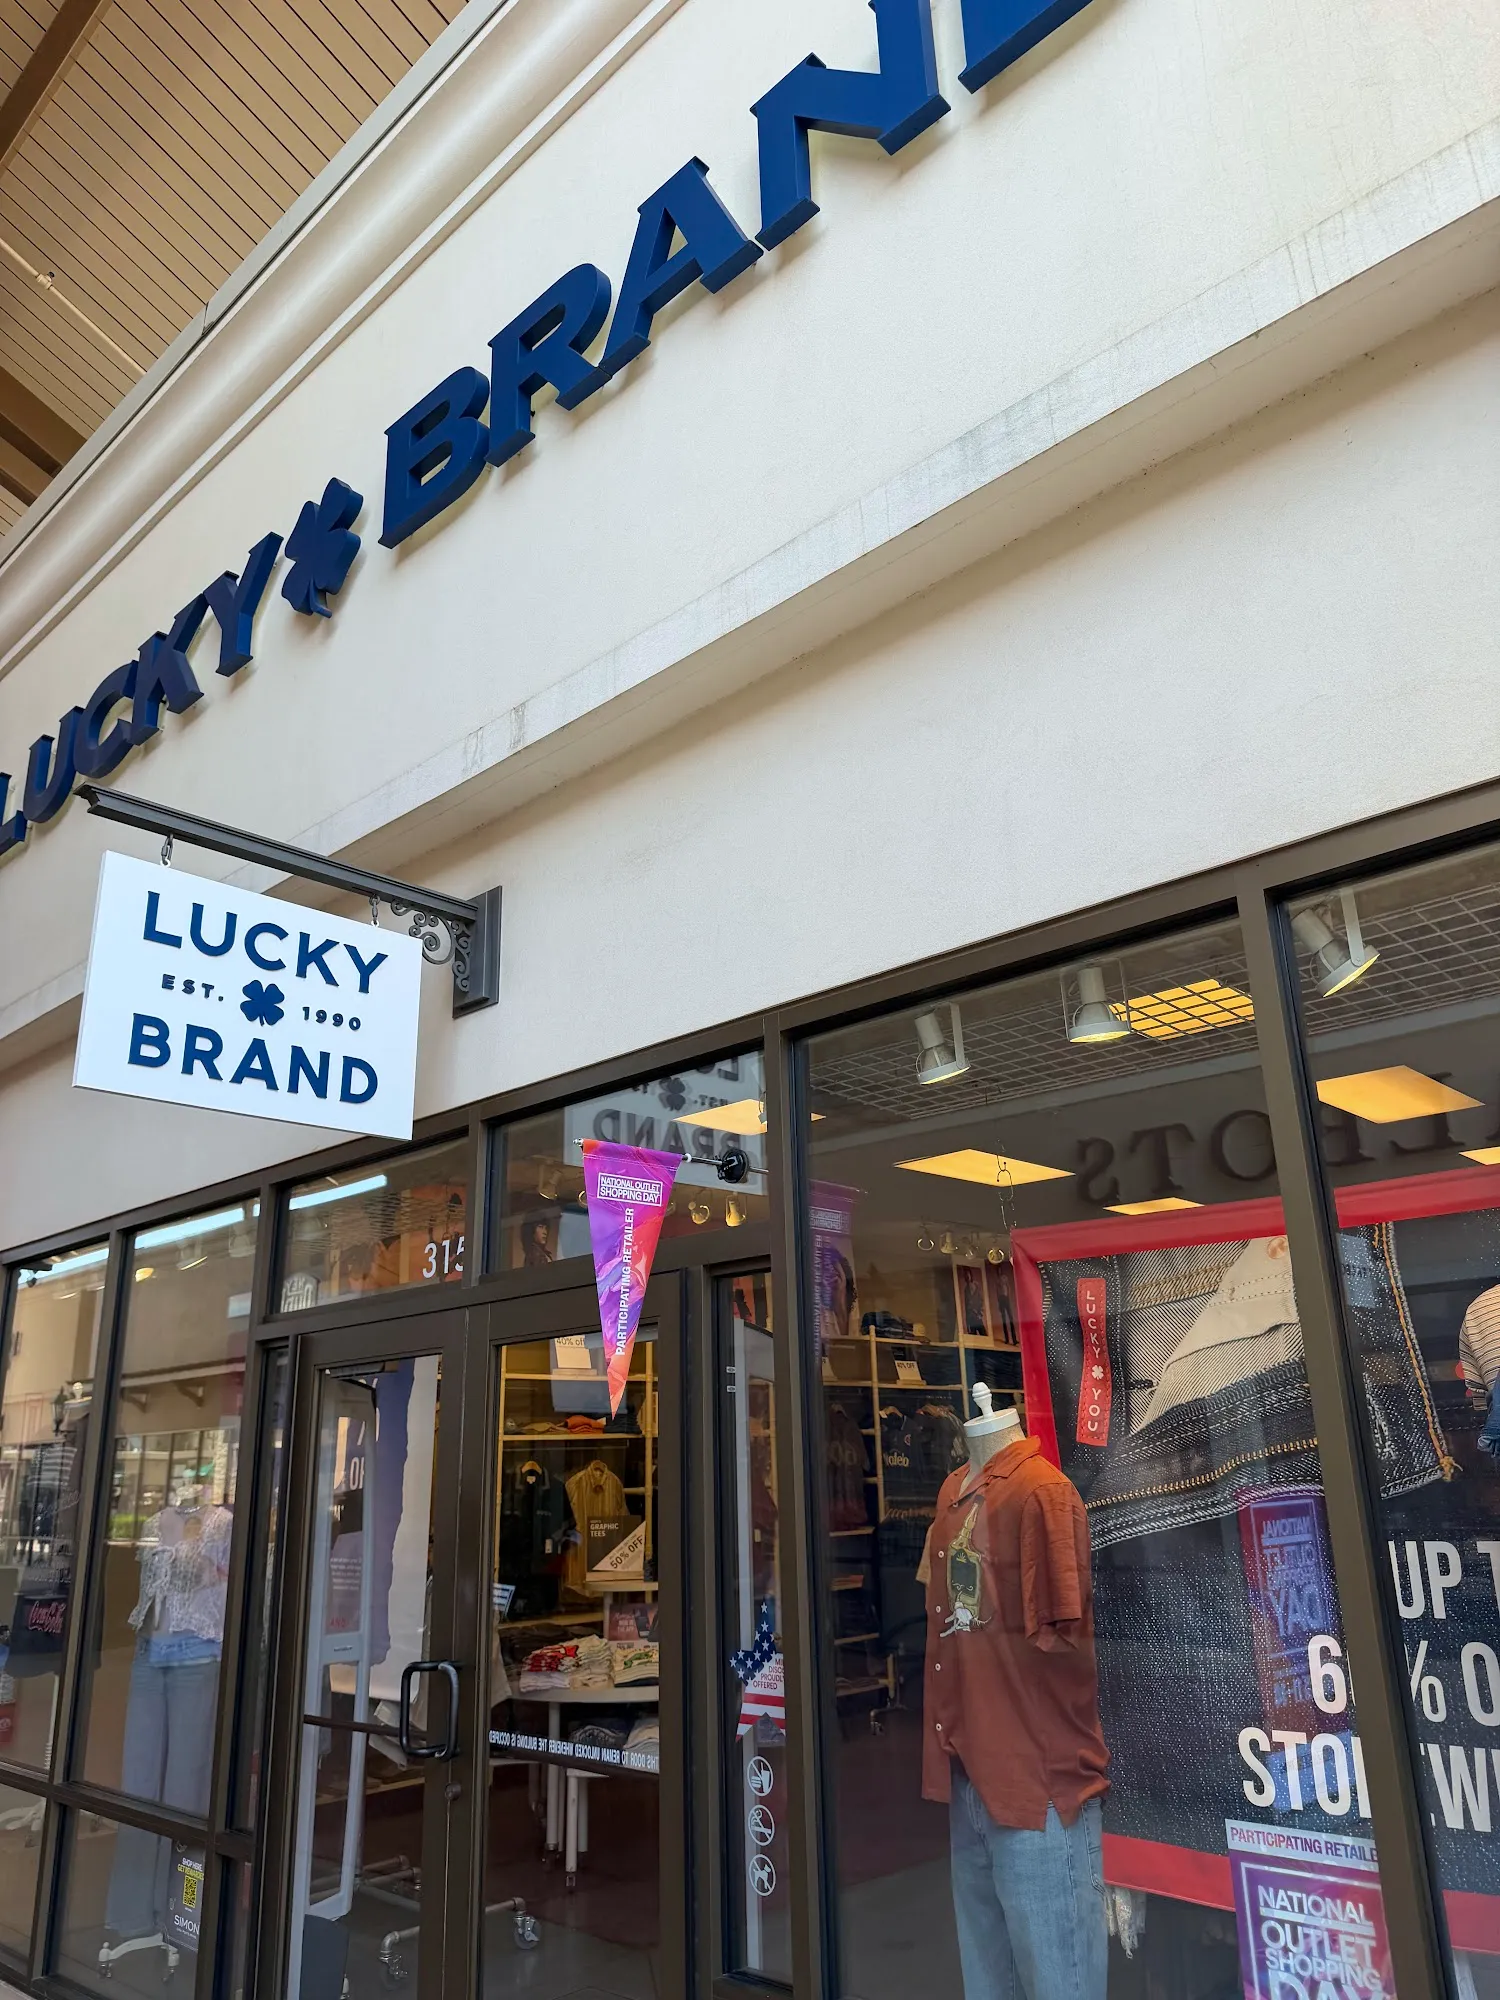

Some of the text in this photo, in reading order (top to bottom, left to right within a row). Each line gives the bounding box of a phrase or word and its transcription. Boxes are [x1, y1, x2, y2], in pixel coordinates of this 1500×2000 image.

[0, 530, 284, 854] LUCKY
[143, 890, 389, 994] LUCKY
[161, 974, 362, 1031] EST. 1990
[127, 1012, 380, 1104] BRAND
[600, 1186, 661, 1204] SHOPPING DAY
[601, 1176, 661, 1192] NATIONAL OUTLET
[422, 1236, 465, 1278] 315
[615, 1207, 635, 1356] PARTICIPATING RETAILER
[1086, 1290, 1101, 1432] LUCKY YOU
[610, 1551, 630, 1569] 50%
[627, 1535, 644, 1553] OFF
[1388, 1540, 1462, 1619] UP
[753, 1680, 778, 1689] OFFERED
[1230, 1826, 1322, 1854] PARTICIPATING
[174, 1915, 200, 1935] SIMON
[1257, 1885, 1374, 1927] NATIONAL
[1261, 1920, 1377, 1969] OUTLET
[1265, 1947, 1381, 1991] SHOPPING
